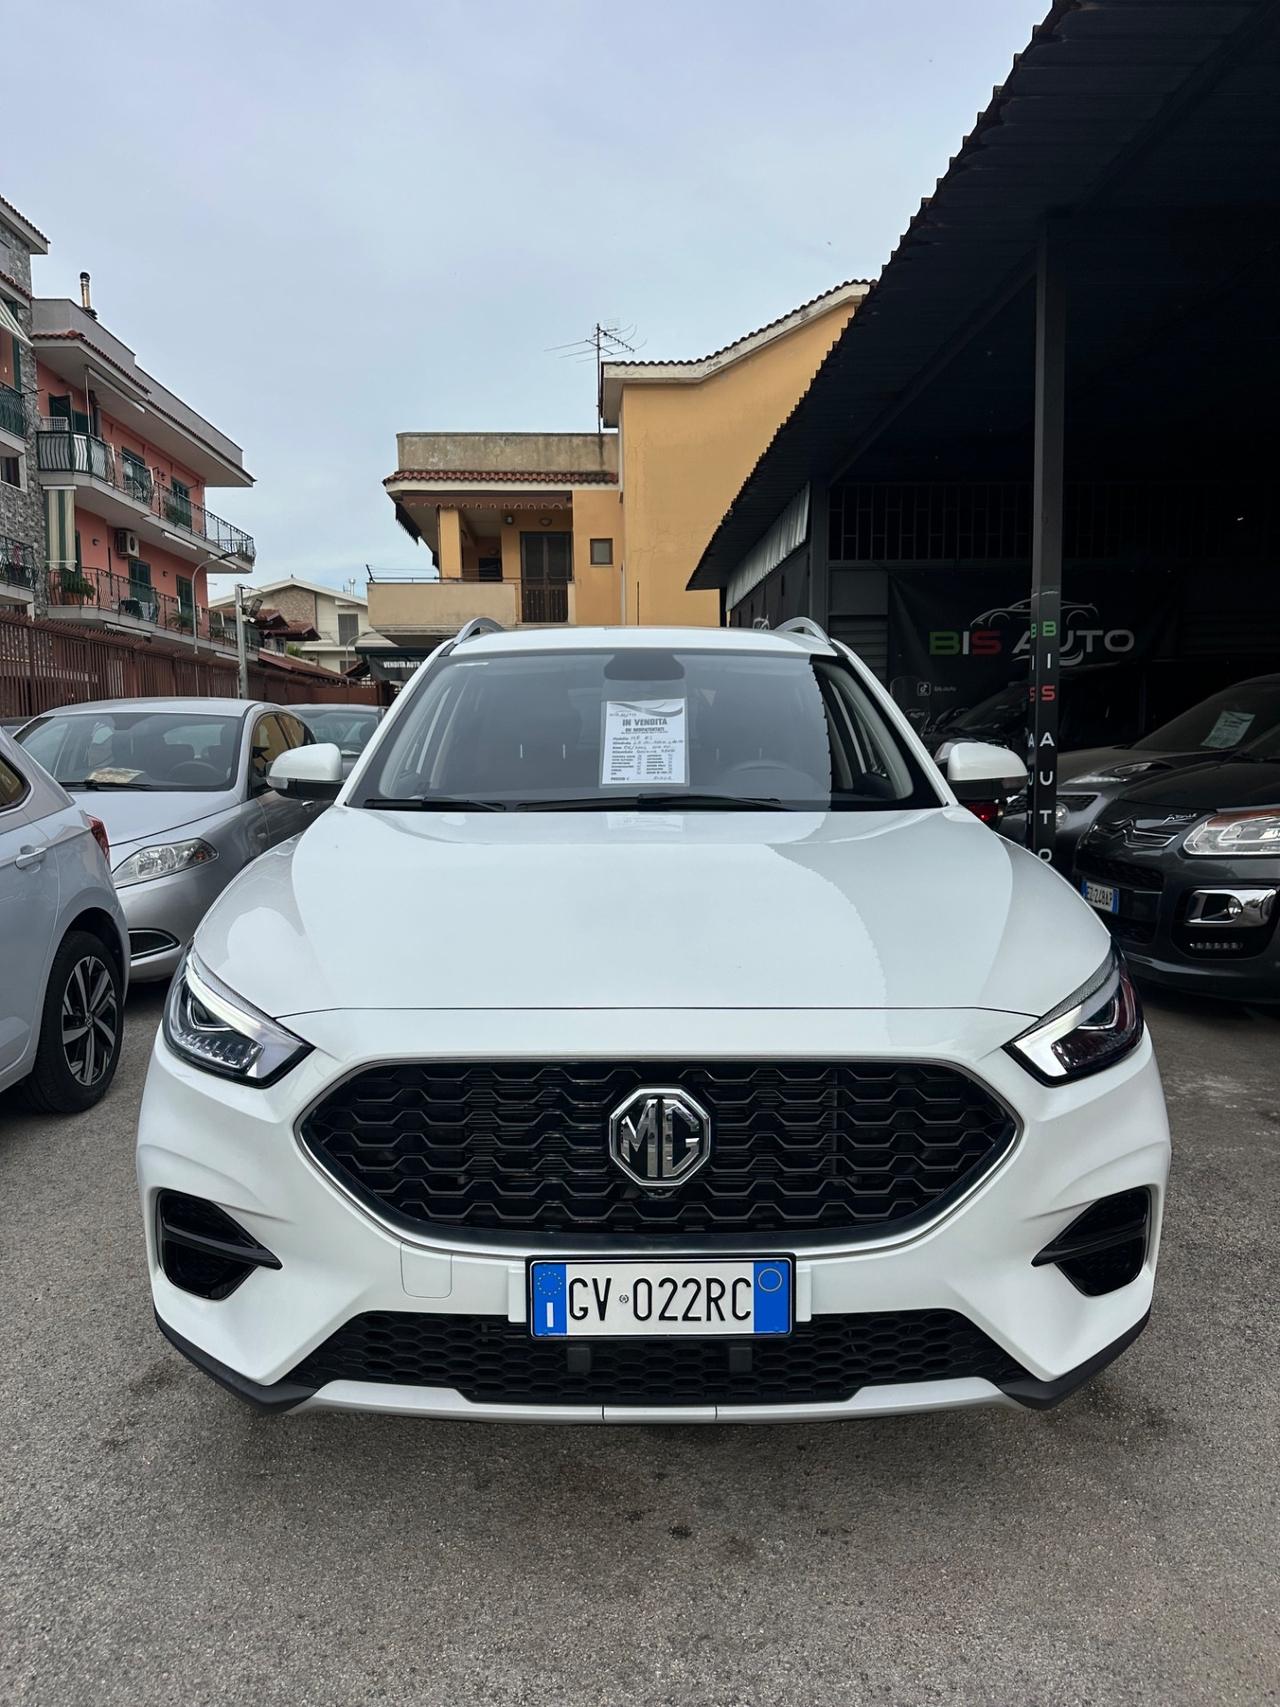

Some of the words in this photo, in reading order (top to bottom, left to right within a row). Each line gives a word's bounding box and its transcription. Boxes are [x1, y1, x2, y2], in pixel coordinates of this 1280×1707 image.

[929, 630, 1001, 655] BIS
[634, 718, 667, 726] VENDITA
[621, 1098, 700, 1178] MG
[568, 1277, 612, 1321] GV
[632, 1277, 752, 1321] 022RC
[546, 1302, 554, 1328] I
